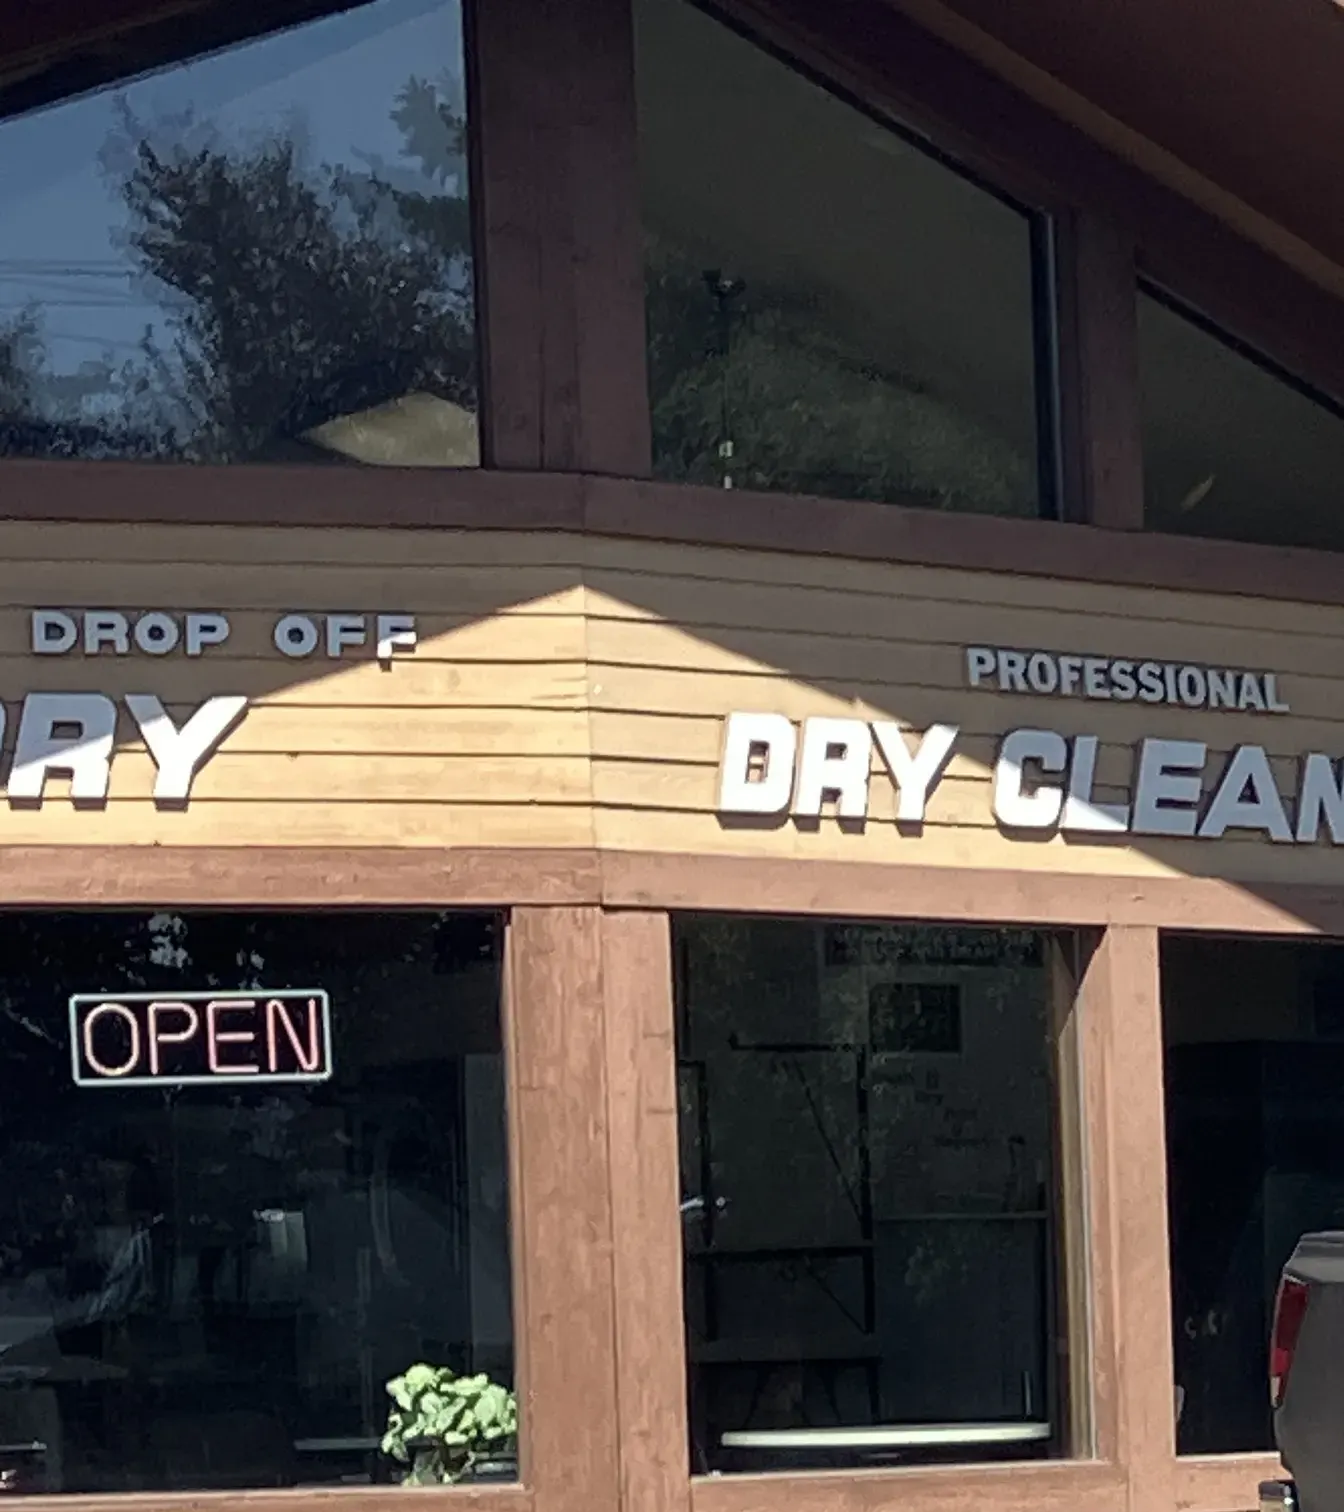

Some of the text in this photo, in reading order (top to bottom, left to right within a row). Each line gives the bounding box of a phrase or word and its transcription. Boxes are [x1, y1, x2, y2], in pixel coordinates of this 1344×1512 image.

[31, 611, 417, 660] DROP OFF
[966, 646, 1289, 713] PROFESSIONAL
[0, 692, 248, 798] RY
[719, 711, 960, 822] DRY
[83, 998, 323, 1077] OPEN
